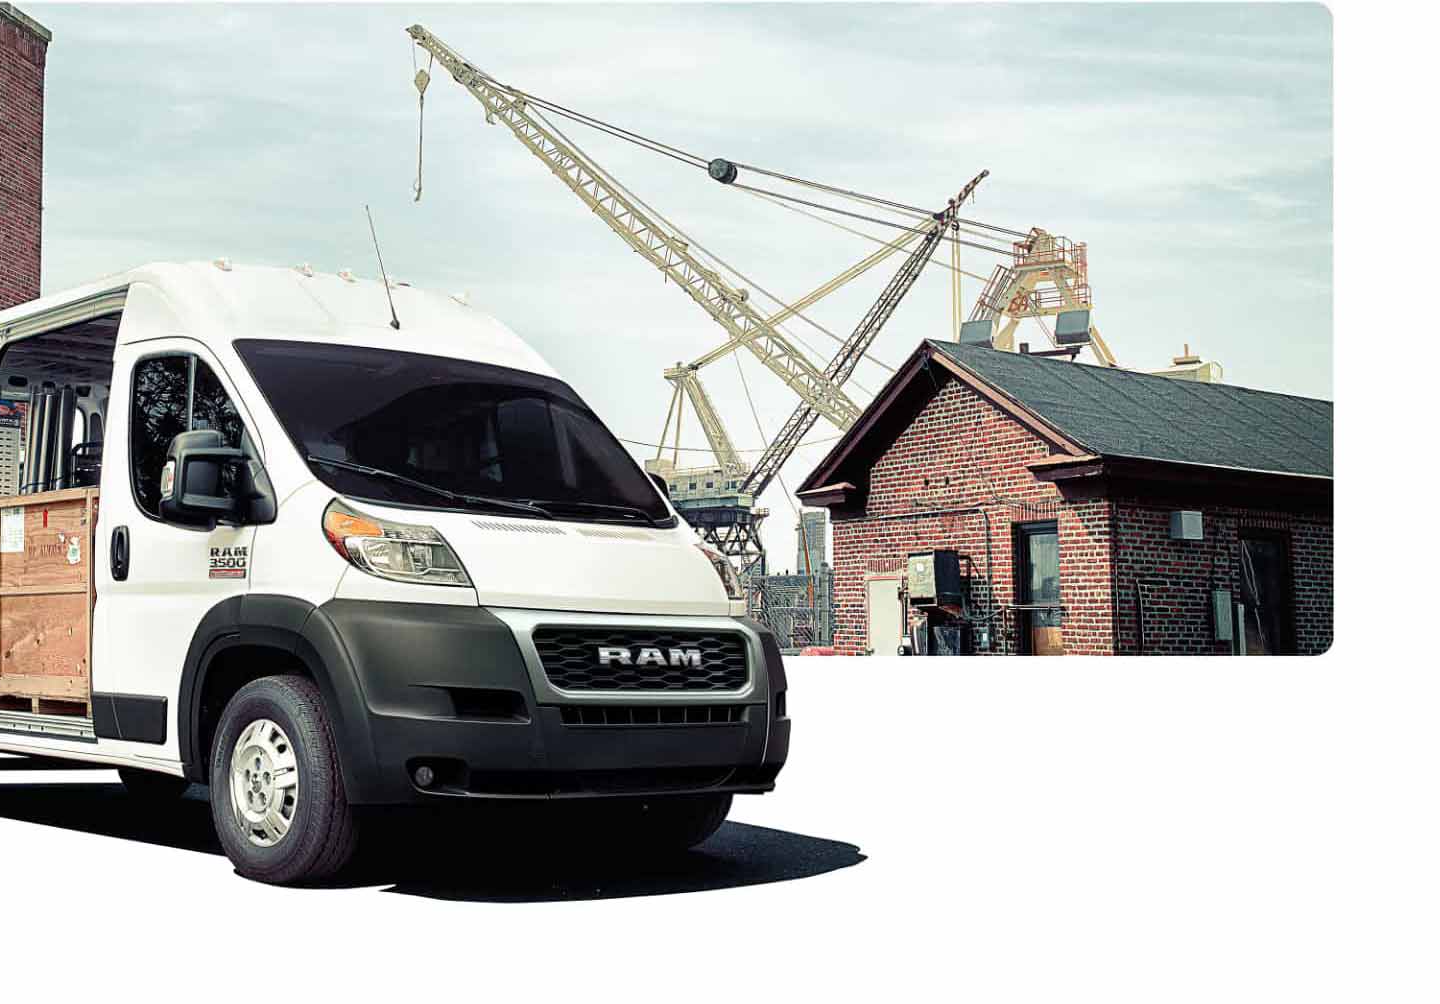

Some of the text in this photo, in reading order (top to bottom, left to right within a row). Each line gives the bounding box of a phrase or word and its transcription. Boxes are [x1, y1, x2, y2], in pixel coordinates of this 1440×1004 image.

[210, 546, 248, 557] RAM
[209, 557, 246, 568] 3500
[598, 646, 703, 669] RAM
